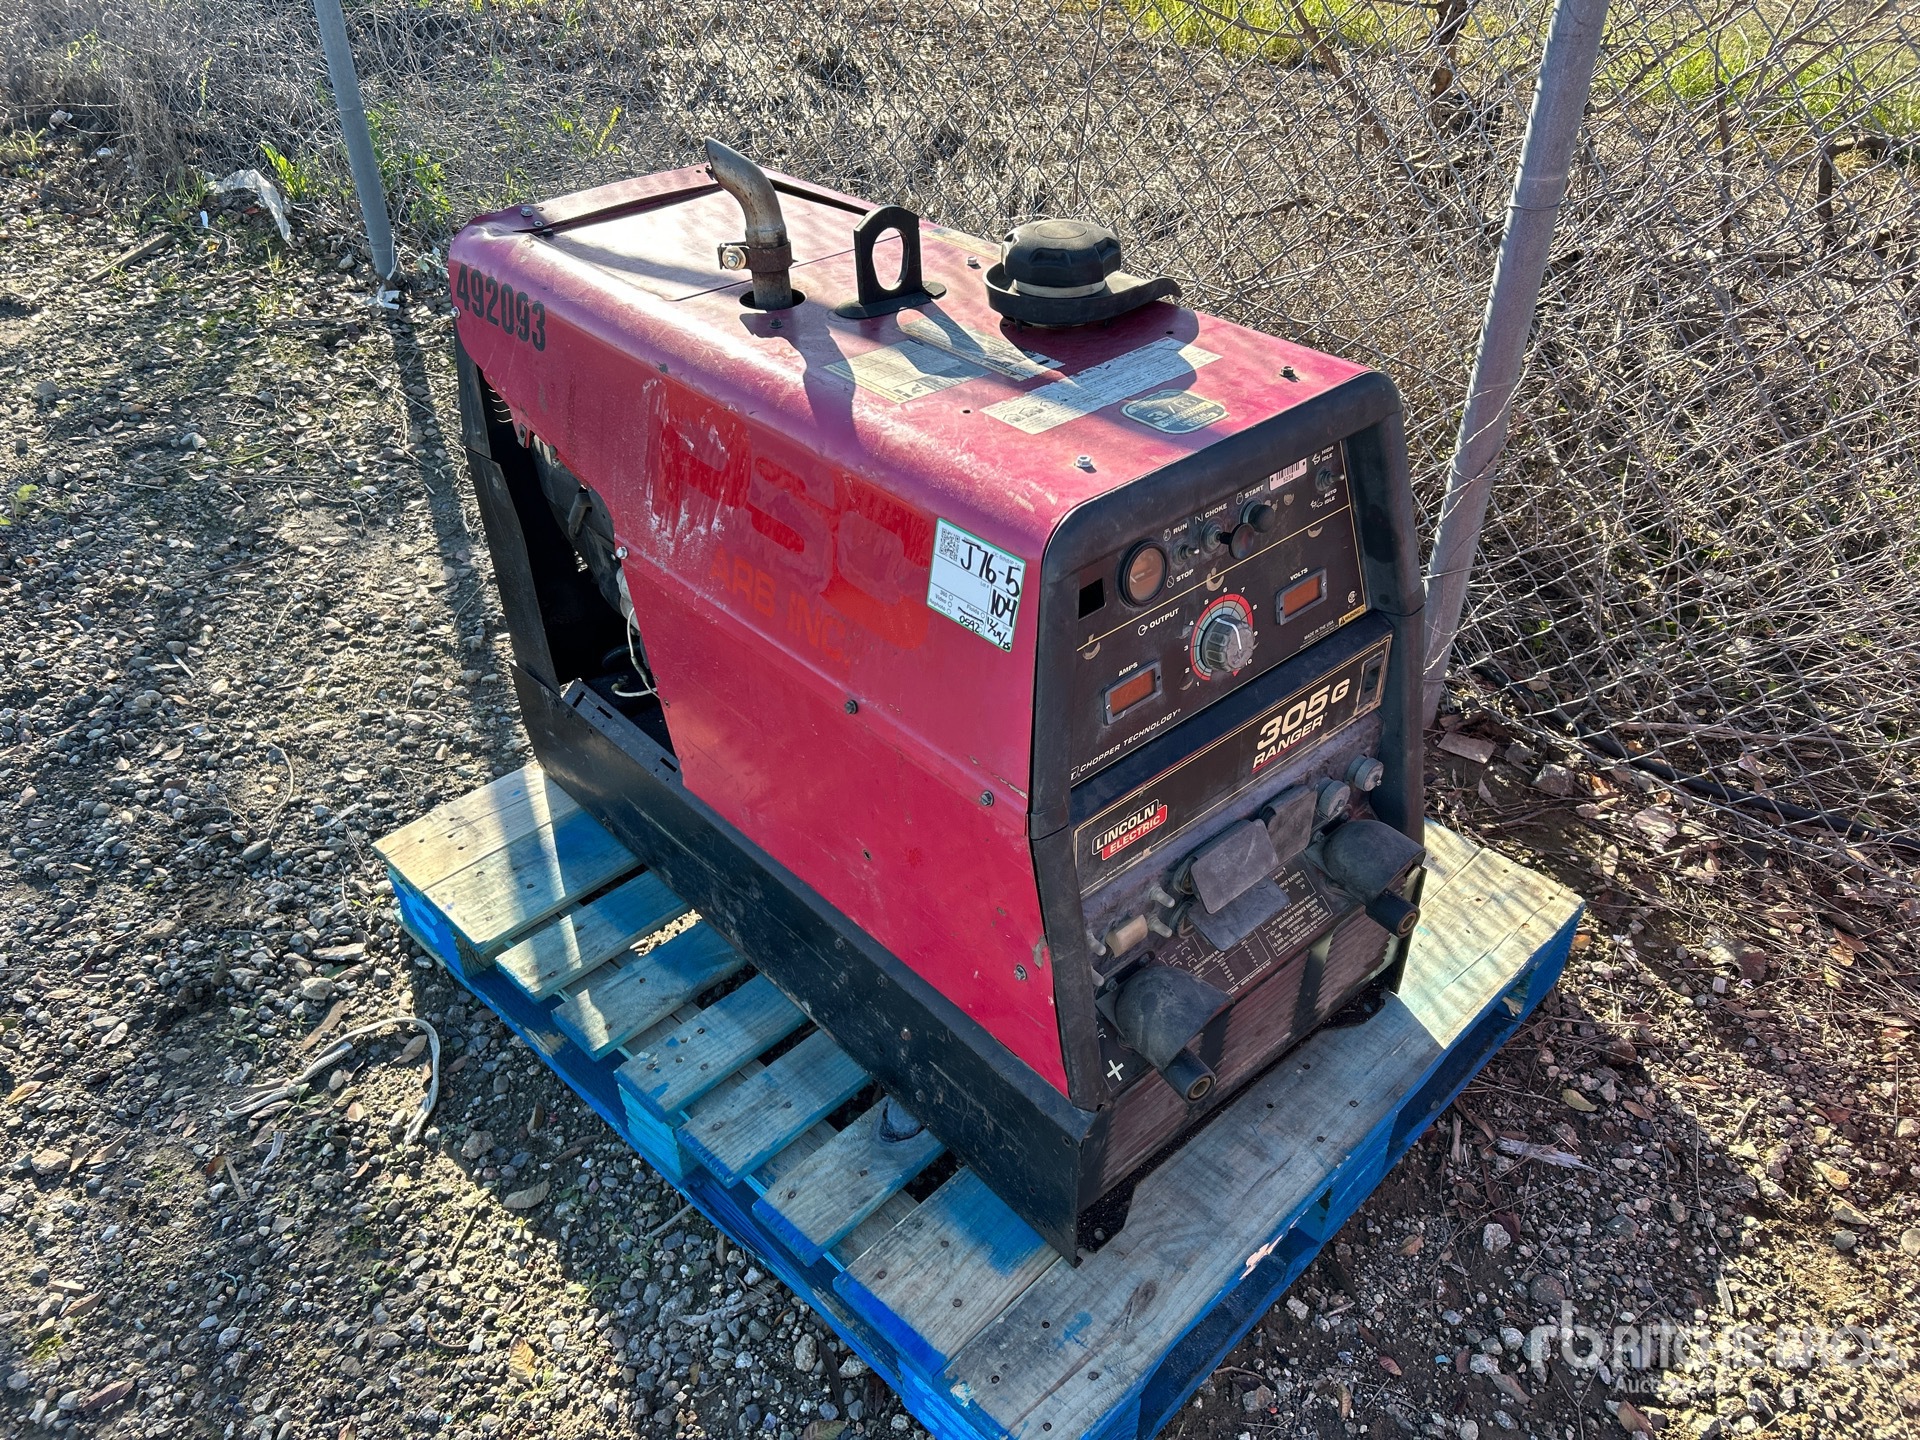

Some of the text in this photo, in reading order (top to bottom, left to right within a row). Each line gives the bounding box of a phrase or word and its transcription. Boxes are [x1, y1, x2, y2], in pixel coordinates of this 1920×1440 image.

[457, 263, 546, 352] 492093
[1322, 446, 1334, 454] HIGH
[1322, 452, 1333, 462] IDLE
[1244, 484, 1264, 499] START
[1324, 488, 1337, 498] AUTO
[1324, 496, 1336, 504] IDLE
[1204, 502, 1228, 519] CHOKE
[1173, 523, 1188, 535] RUN
[961, 539, 1021, 597] J76-5
[1176, 568, 1194, 583] STOP
[1290, 568, 1308, 580] VOLTS
[710, 545, 777, 618] ARB
[936, 594, 946, 604] Video
[990, 589, 1018, 628] 104
[1150, 608, 1180, 629] OUTPUT
[1118, 662, 1138, 676] AMPS
[1253, 715, 1324, 768] RANGER
[1080, 744, 1120, 772] CHOPPER
[1096, 804, 1154, 850] LINCOLN
[1110, 816, 1160, 853] ELECTRIC
